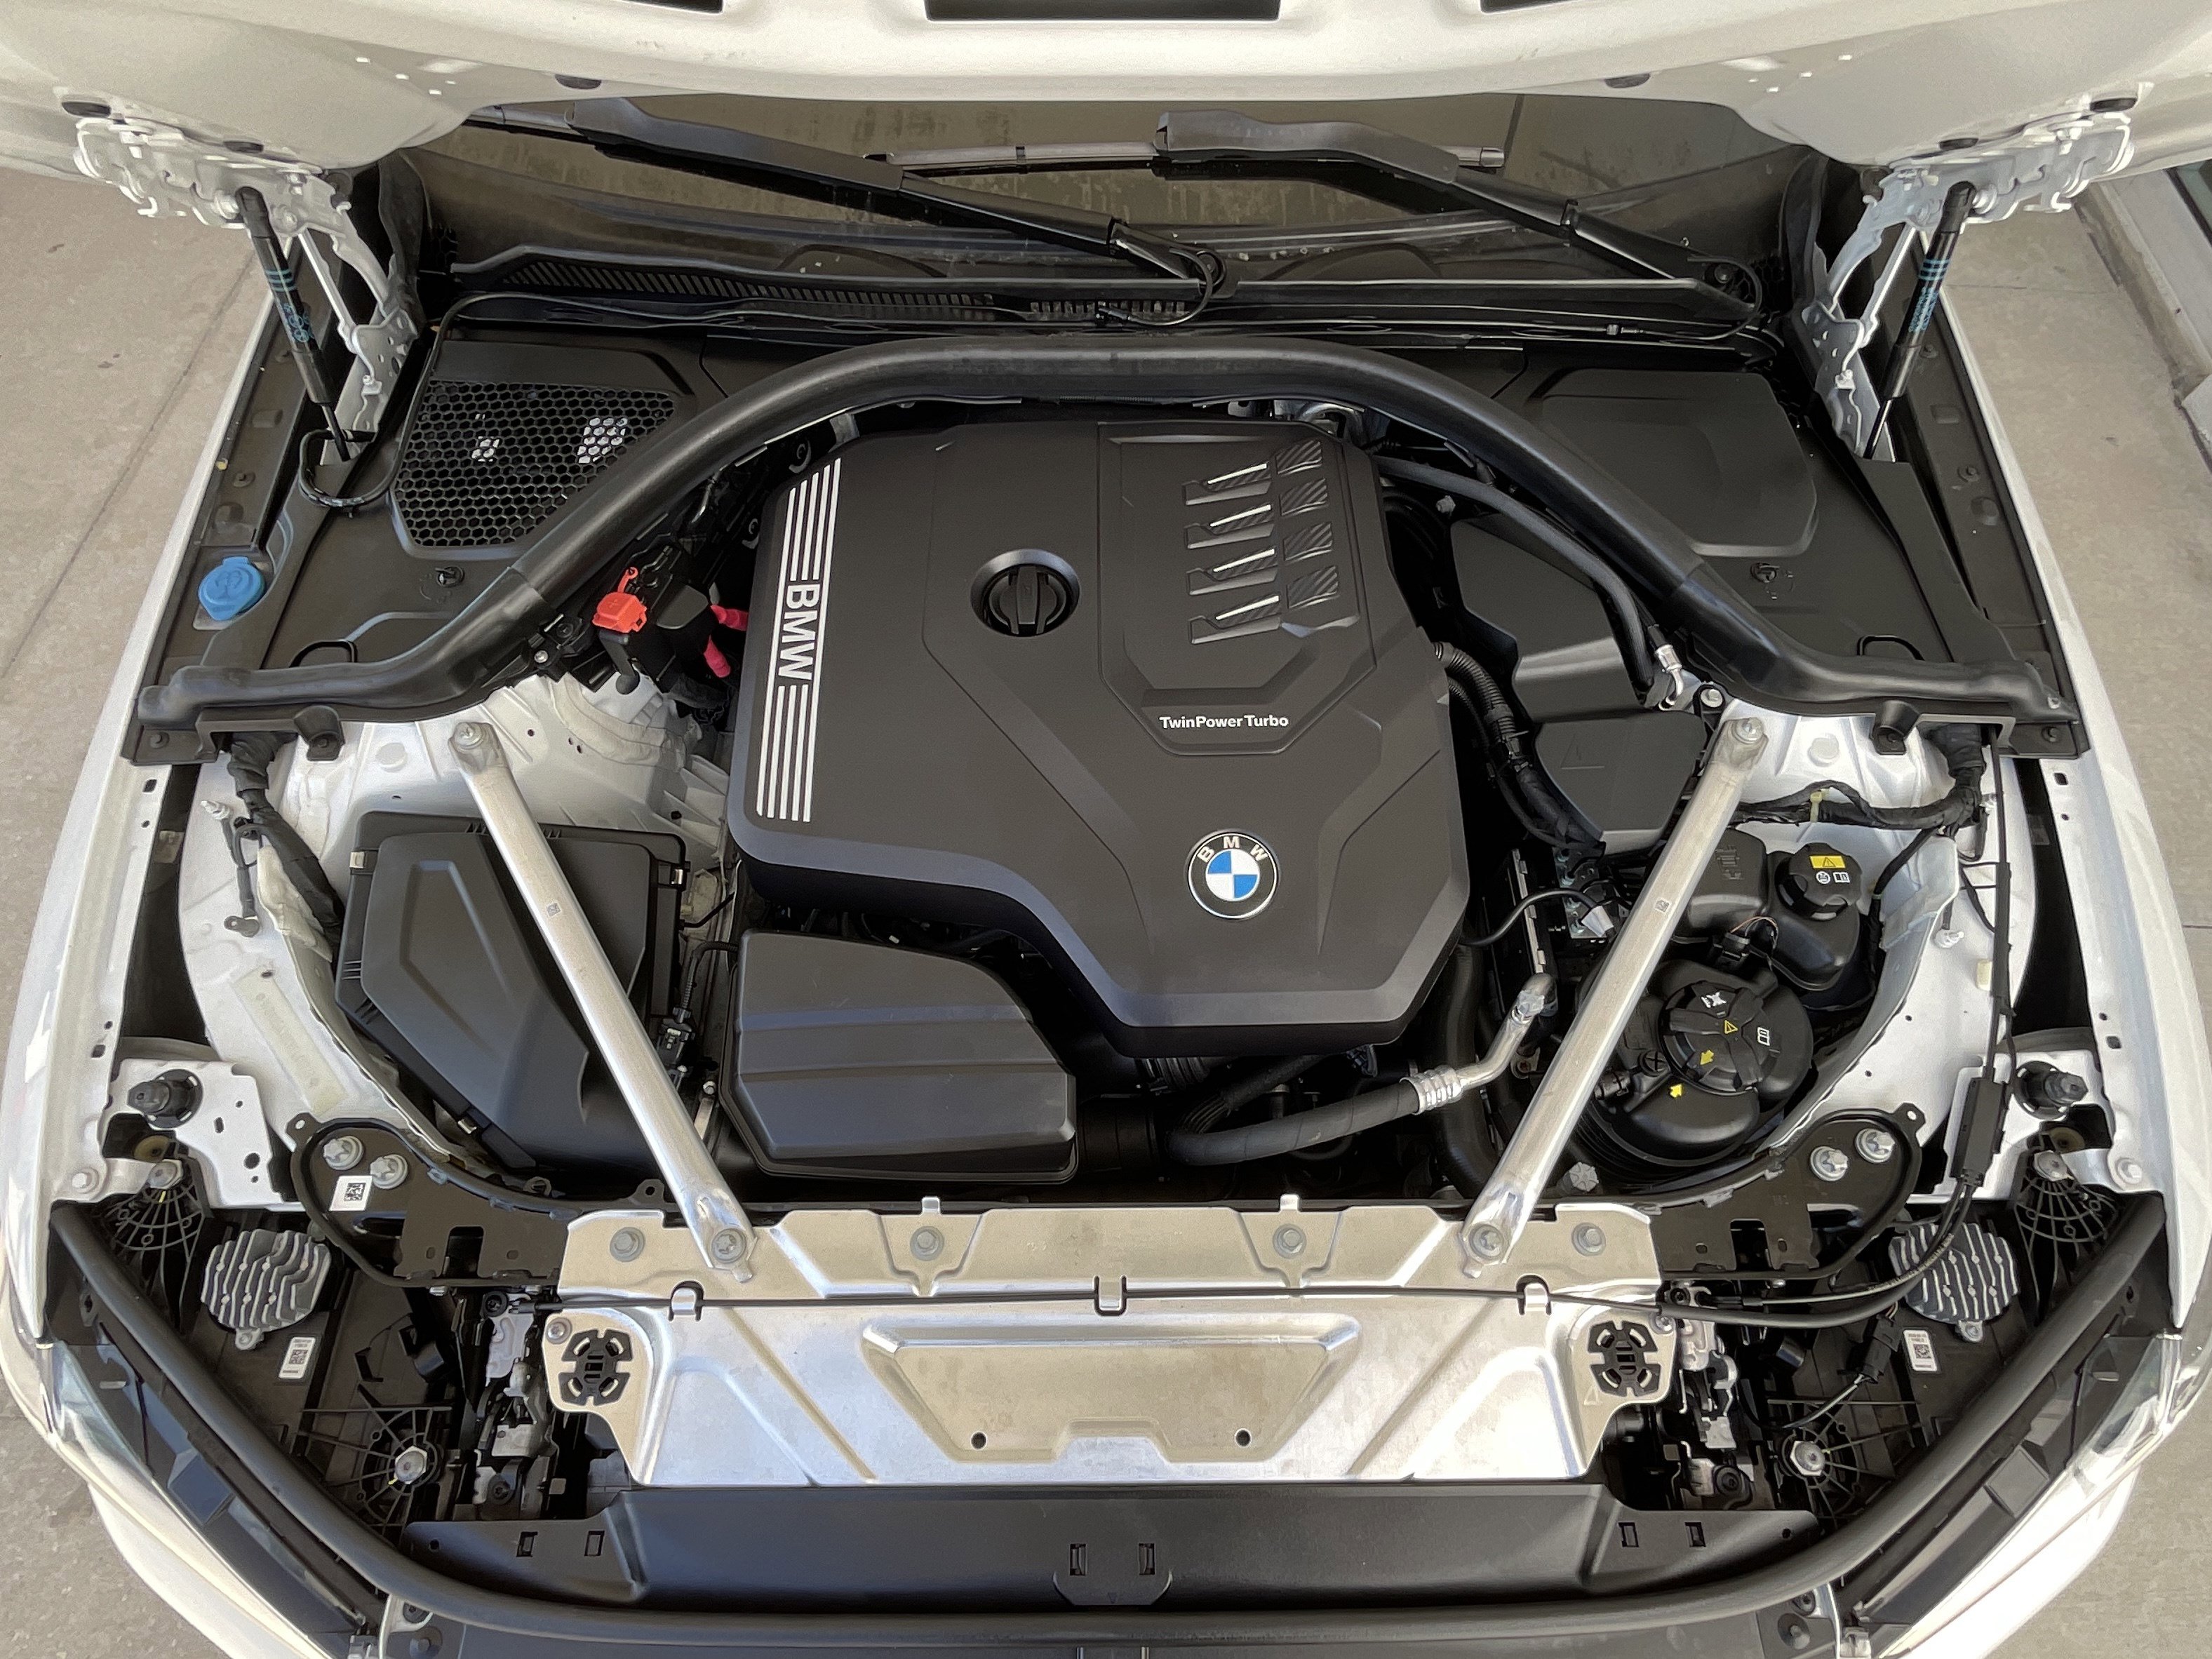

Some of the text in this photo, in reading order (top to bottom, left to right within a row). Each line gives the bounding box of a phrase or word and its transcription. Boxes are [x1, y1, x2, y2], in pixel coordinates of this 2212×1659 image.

[778, 584, 820, 680] BMW
[1159, 714, 1289, 729] TwinPower Turbo
[1197, 836, 1268, 863] BMW
